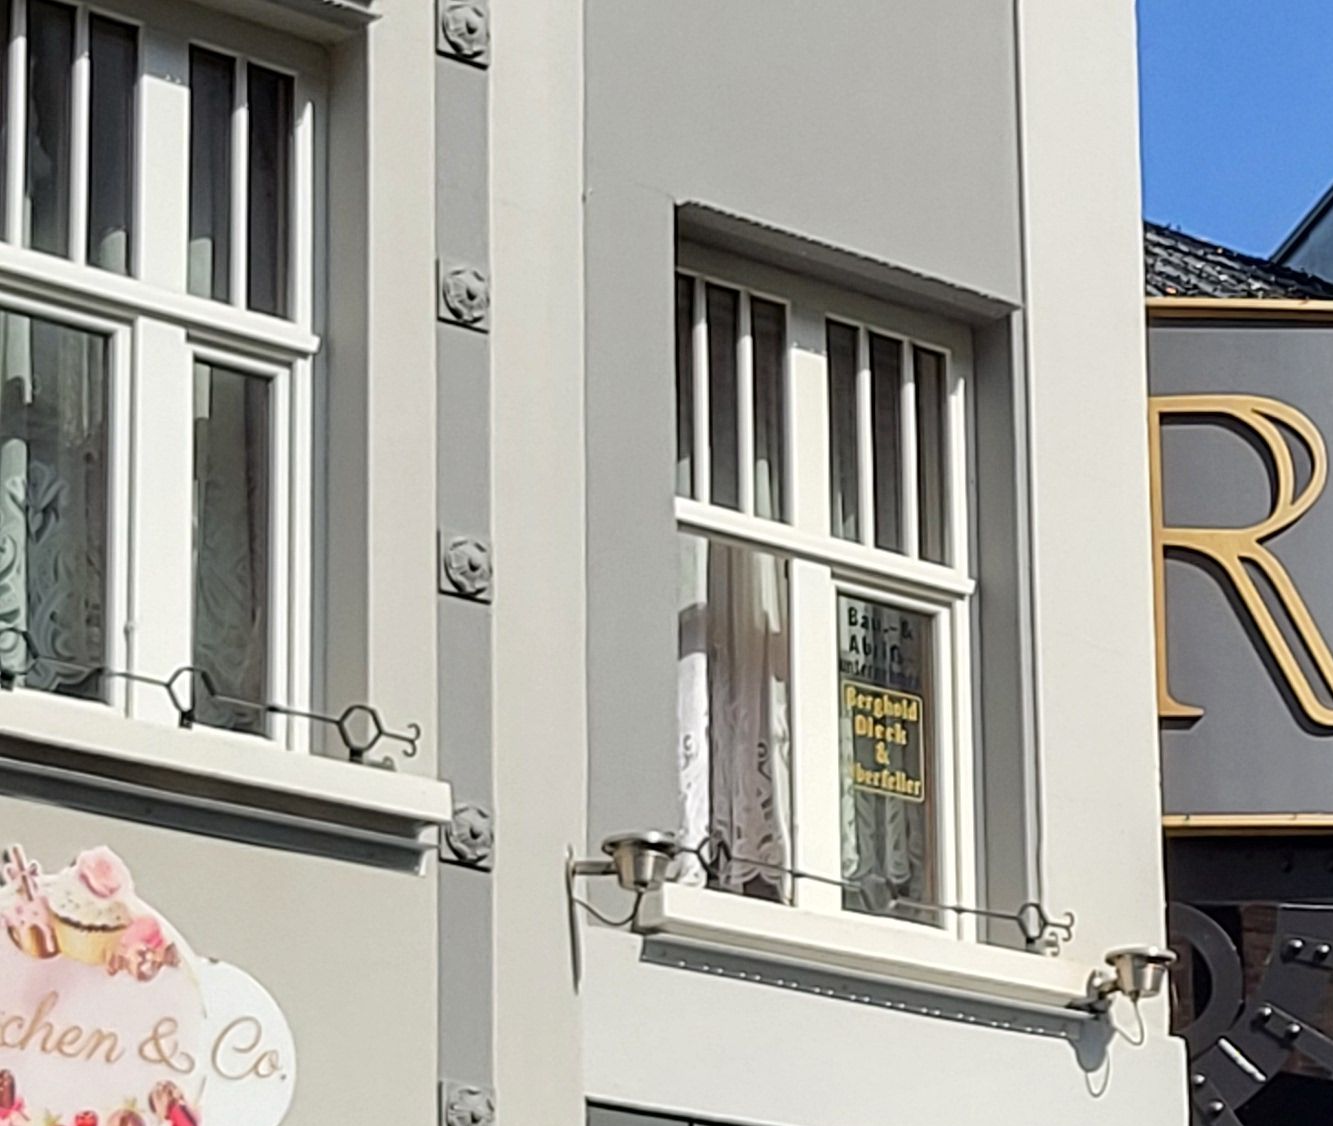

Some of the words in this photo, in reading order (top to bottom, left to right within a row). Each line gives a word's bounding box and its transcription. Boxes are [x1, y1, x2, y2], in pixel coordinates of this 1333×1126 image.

[846, 686, 918, 721] Berghold
[874, 740, 890, 765] &
[0, 989, 126, 1064] chen
[138, 1016, 196, 1075] &
[210, 1016, 288, 1081] Co.
